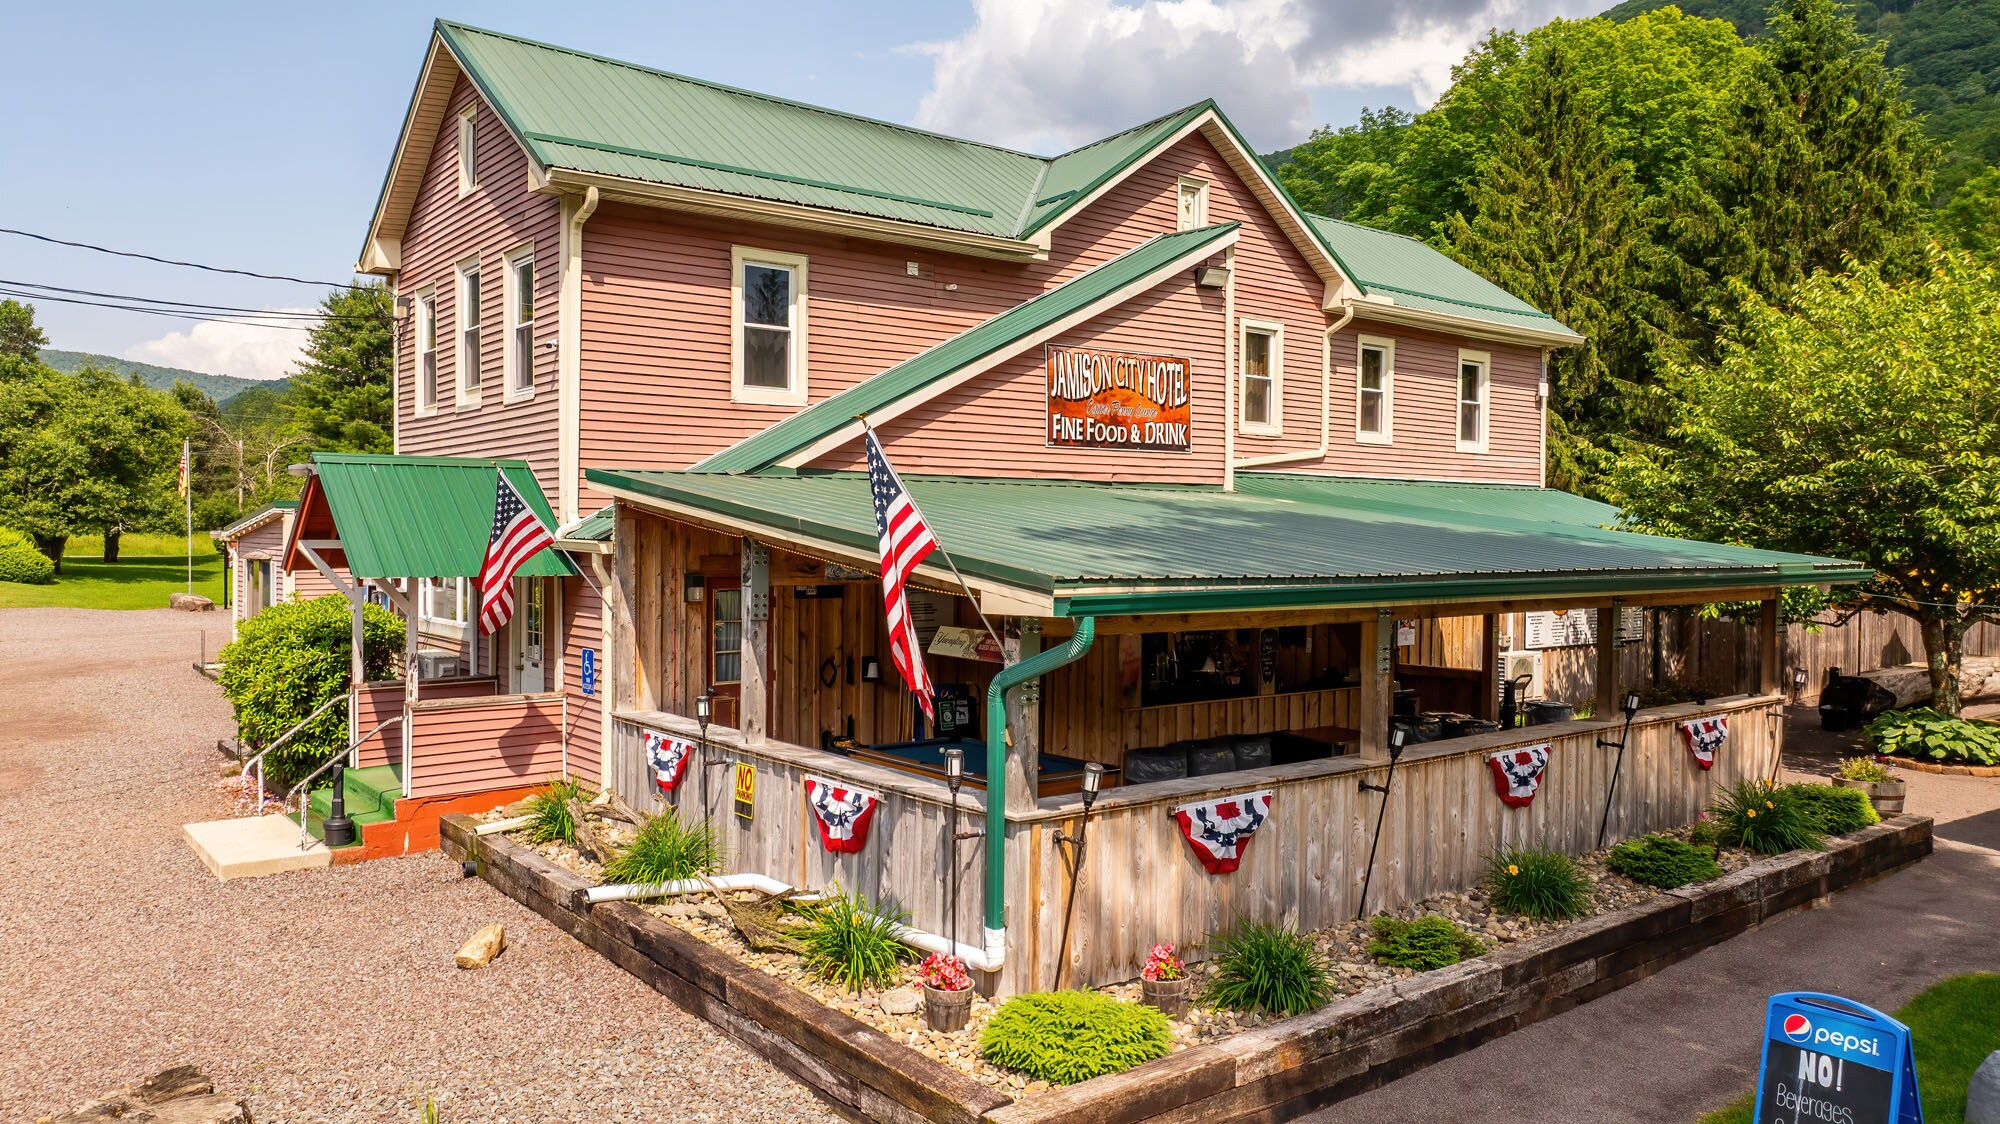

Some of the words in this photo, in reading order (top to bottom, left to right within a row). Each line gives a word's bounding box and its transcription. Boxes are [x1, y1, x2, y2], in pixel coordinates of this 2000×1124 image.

[1051, 351, 1112, 400] JAMISON
[1115, 356, 1144, 395] CITY
[1147, 359, 1188, 407] HOTEL
[1052, 413, 1084, 441] FINE
[1086, 417, 1127, 443] FOOD
[1130, 423, 1141, 443] &
[1145, 422, 1188, 446] DRINK
[934, 631, 967, 649] Yuengling
[737, 766, 752, 791] NO
[736, 789, 752, 802] PARKING
[1814, 1027, 1879, 1056] pepsi
[1798, 1050, 1844, 1092] NO!
[1776, 1083, 1853, 1124] Beverages
